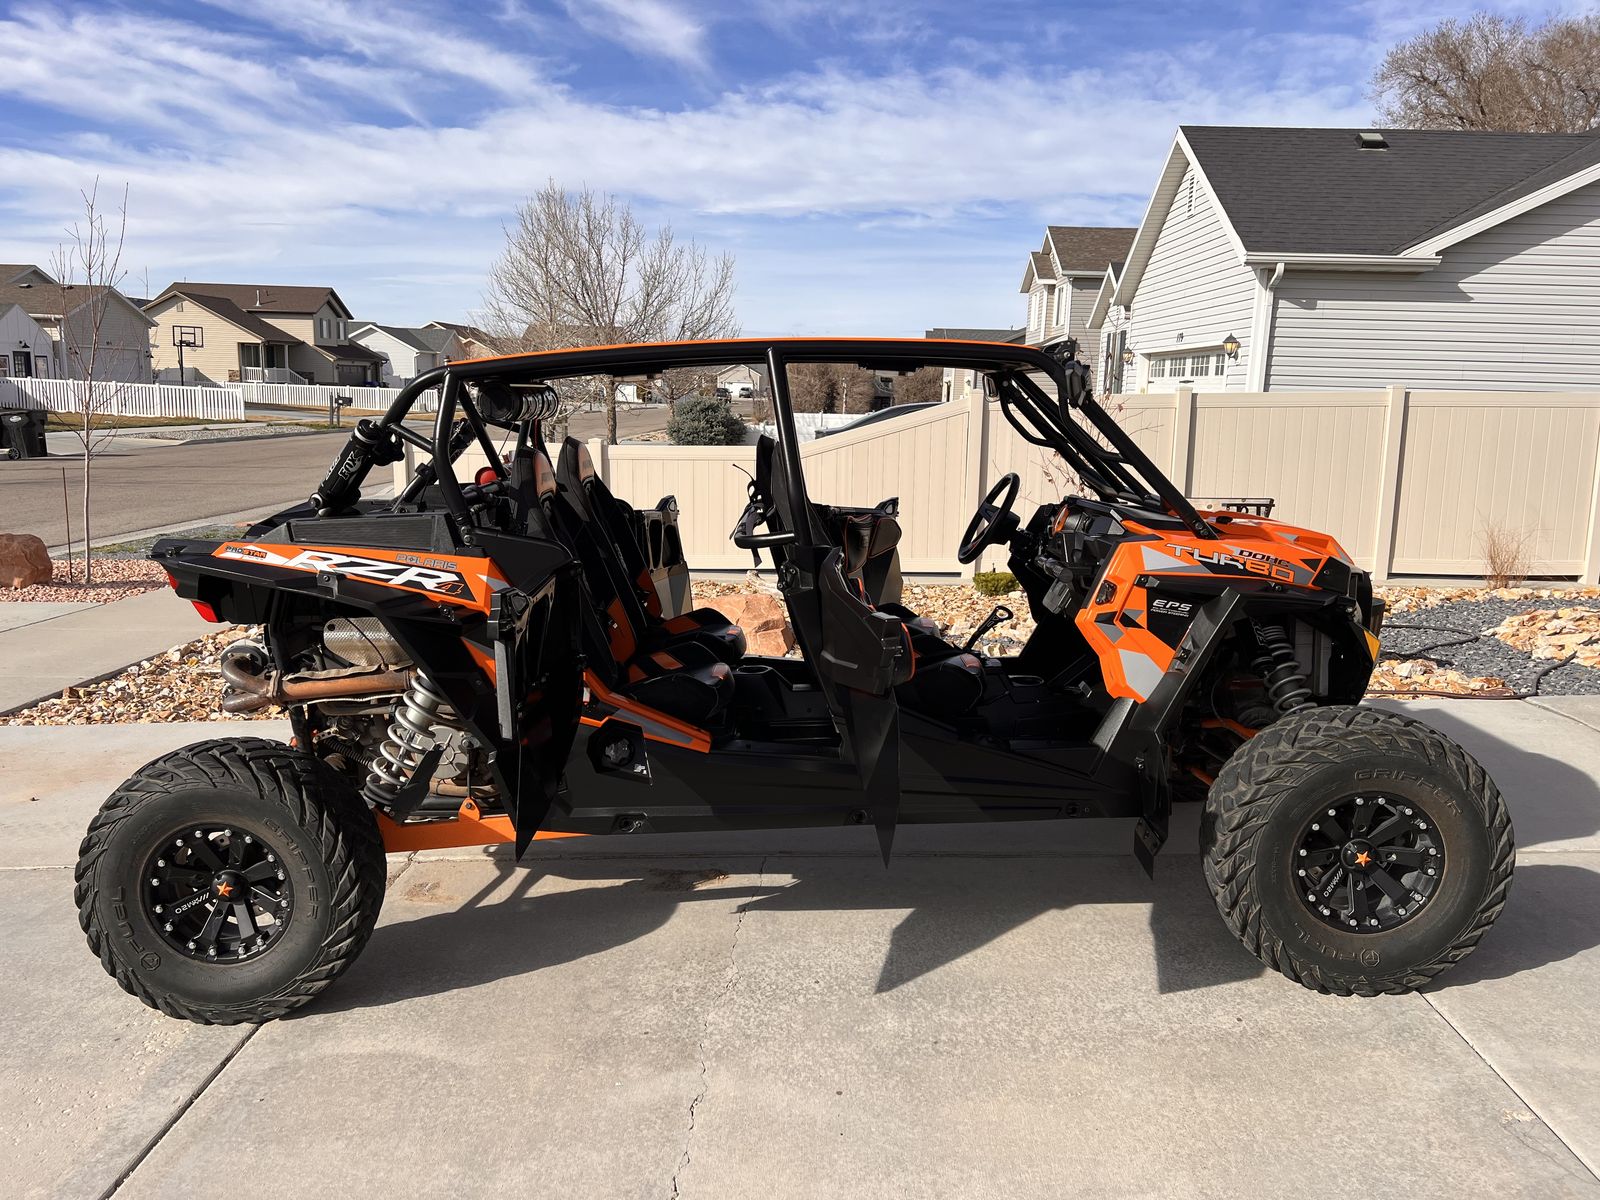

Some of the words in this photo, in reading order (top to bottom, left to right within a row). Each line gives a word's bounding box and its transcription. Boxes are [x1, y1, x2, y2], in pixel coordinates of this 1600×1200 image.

[338, 451, 362, 480] FOX
[225, 545, 268, 559] PROSTAR
[395, 553, 457, 570] POLARIS
[1238, 549, 1290, 568] DOHC
[286, 550, 460, 592] RZR
[1165, 543, 1295, 583] TURBO
[1152, 599, 1193, 611] EPS
